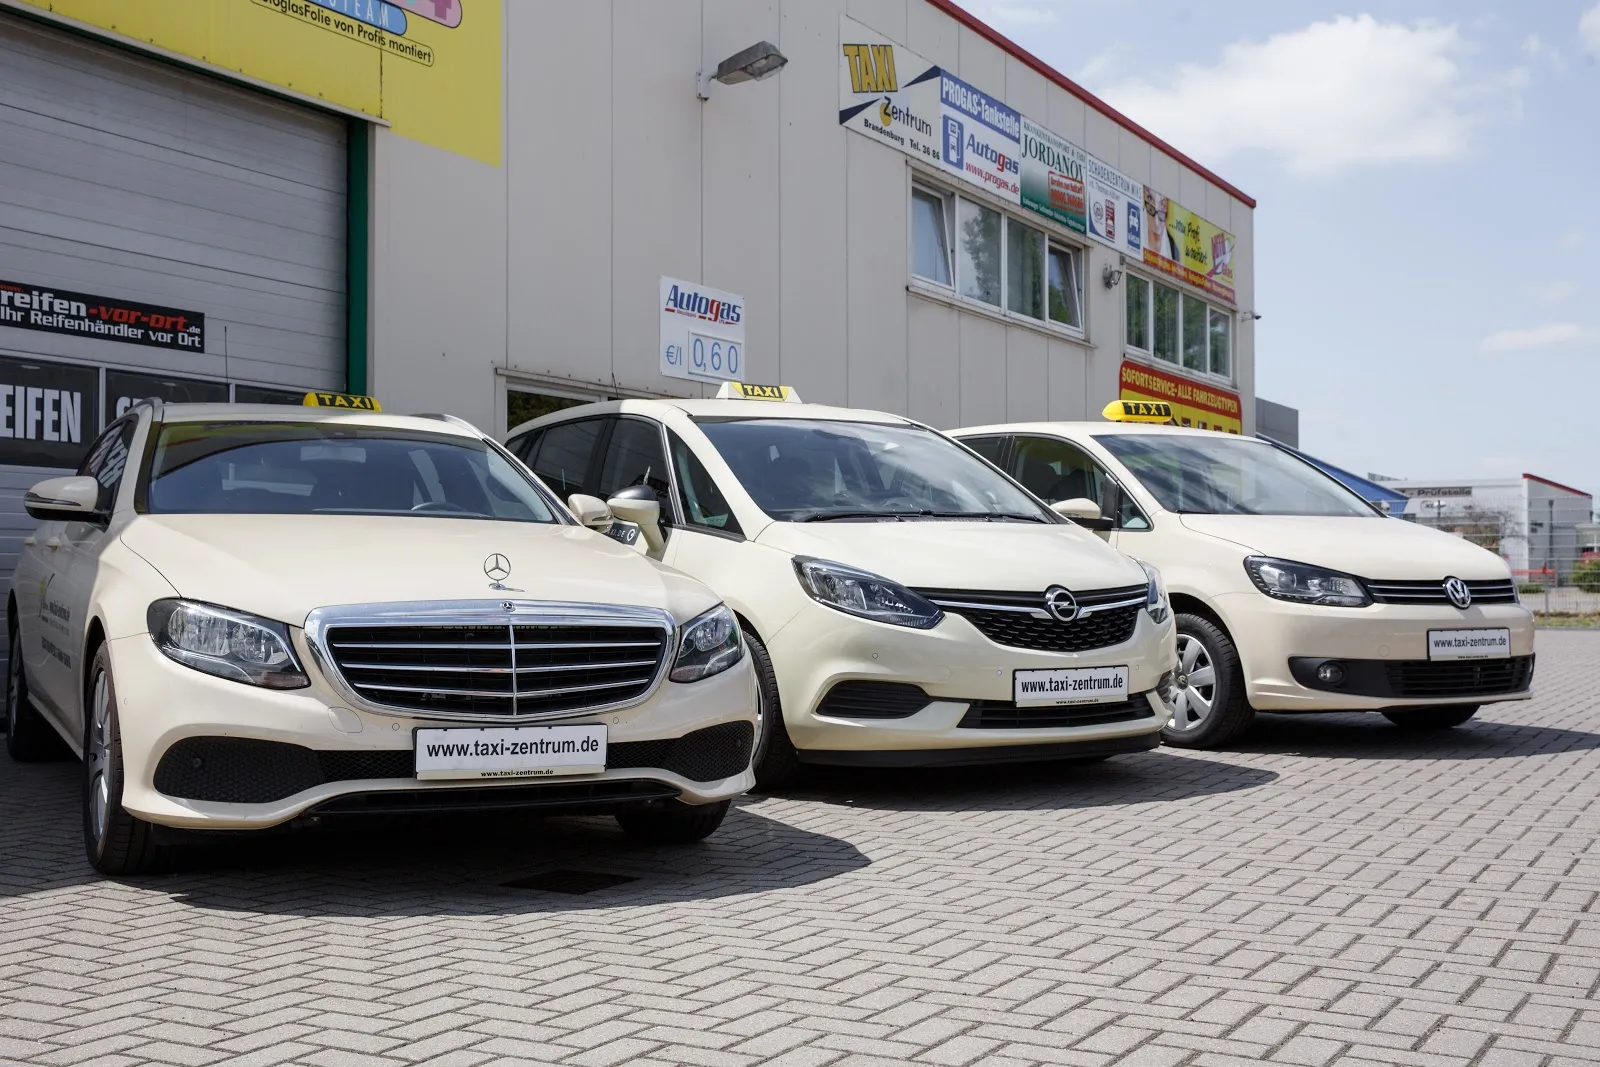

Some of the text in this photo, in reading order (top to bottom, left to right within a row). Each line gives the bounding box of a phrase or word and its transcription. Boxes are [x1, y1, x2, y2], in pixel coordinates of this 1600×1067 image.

[333, 19, 354, 35] von
[357, 24, 386, 47] Profis
[388, 38, 431, 63] montiert
[842, 43, 898, 93] TAXI
[882, 95, 932, 137] Zentrum
[863, 118, 905, 145] Brandenburg
[909, 138, 921, 152] Tel.
[922, 145, 931, 156] 36
[965, 133, 1019, 175] Autogas
[965, 162, 1020, 196] www.progas.de
[665, 284, 742, 323] Autogas
[0, 306, 202, 348] Ihr Reifenhändler vor Ort
[693, 338, 738, 374] 0,60
[319, 394, 371, 409] TAXI
[743, 384, 780, 398] TAXI
[1127, 402, 1166, 416] TAXI
[1433, 635, 1507, 649] www.taxi-zentrum.de
[1021, 673, 1123, 693] www.taxi-zentrum.de
[427, 735, 599, 757] www.taxi-zentrum.de
[480, 768, 554, 777] www.taxi-zentrum.de
